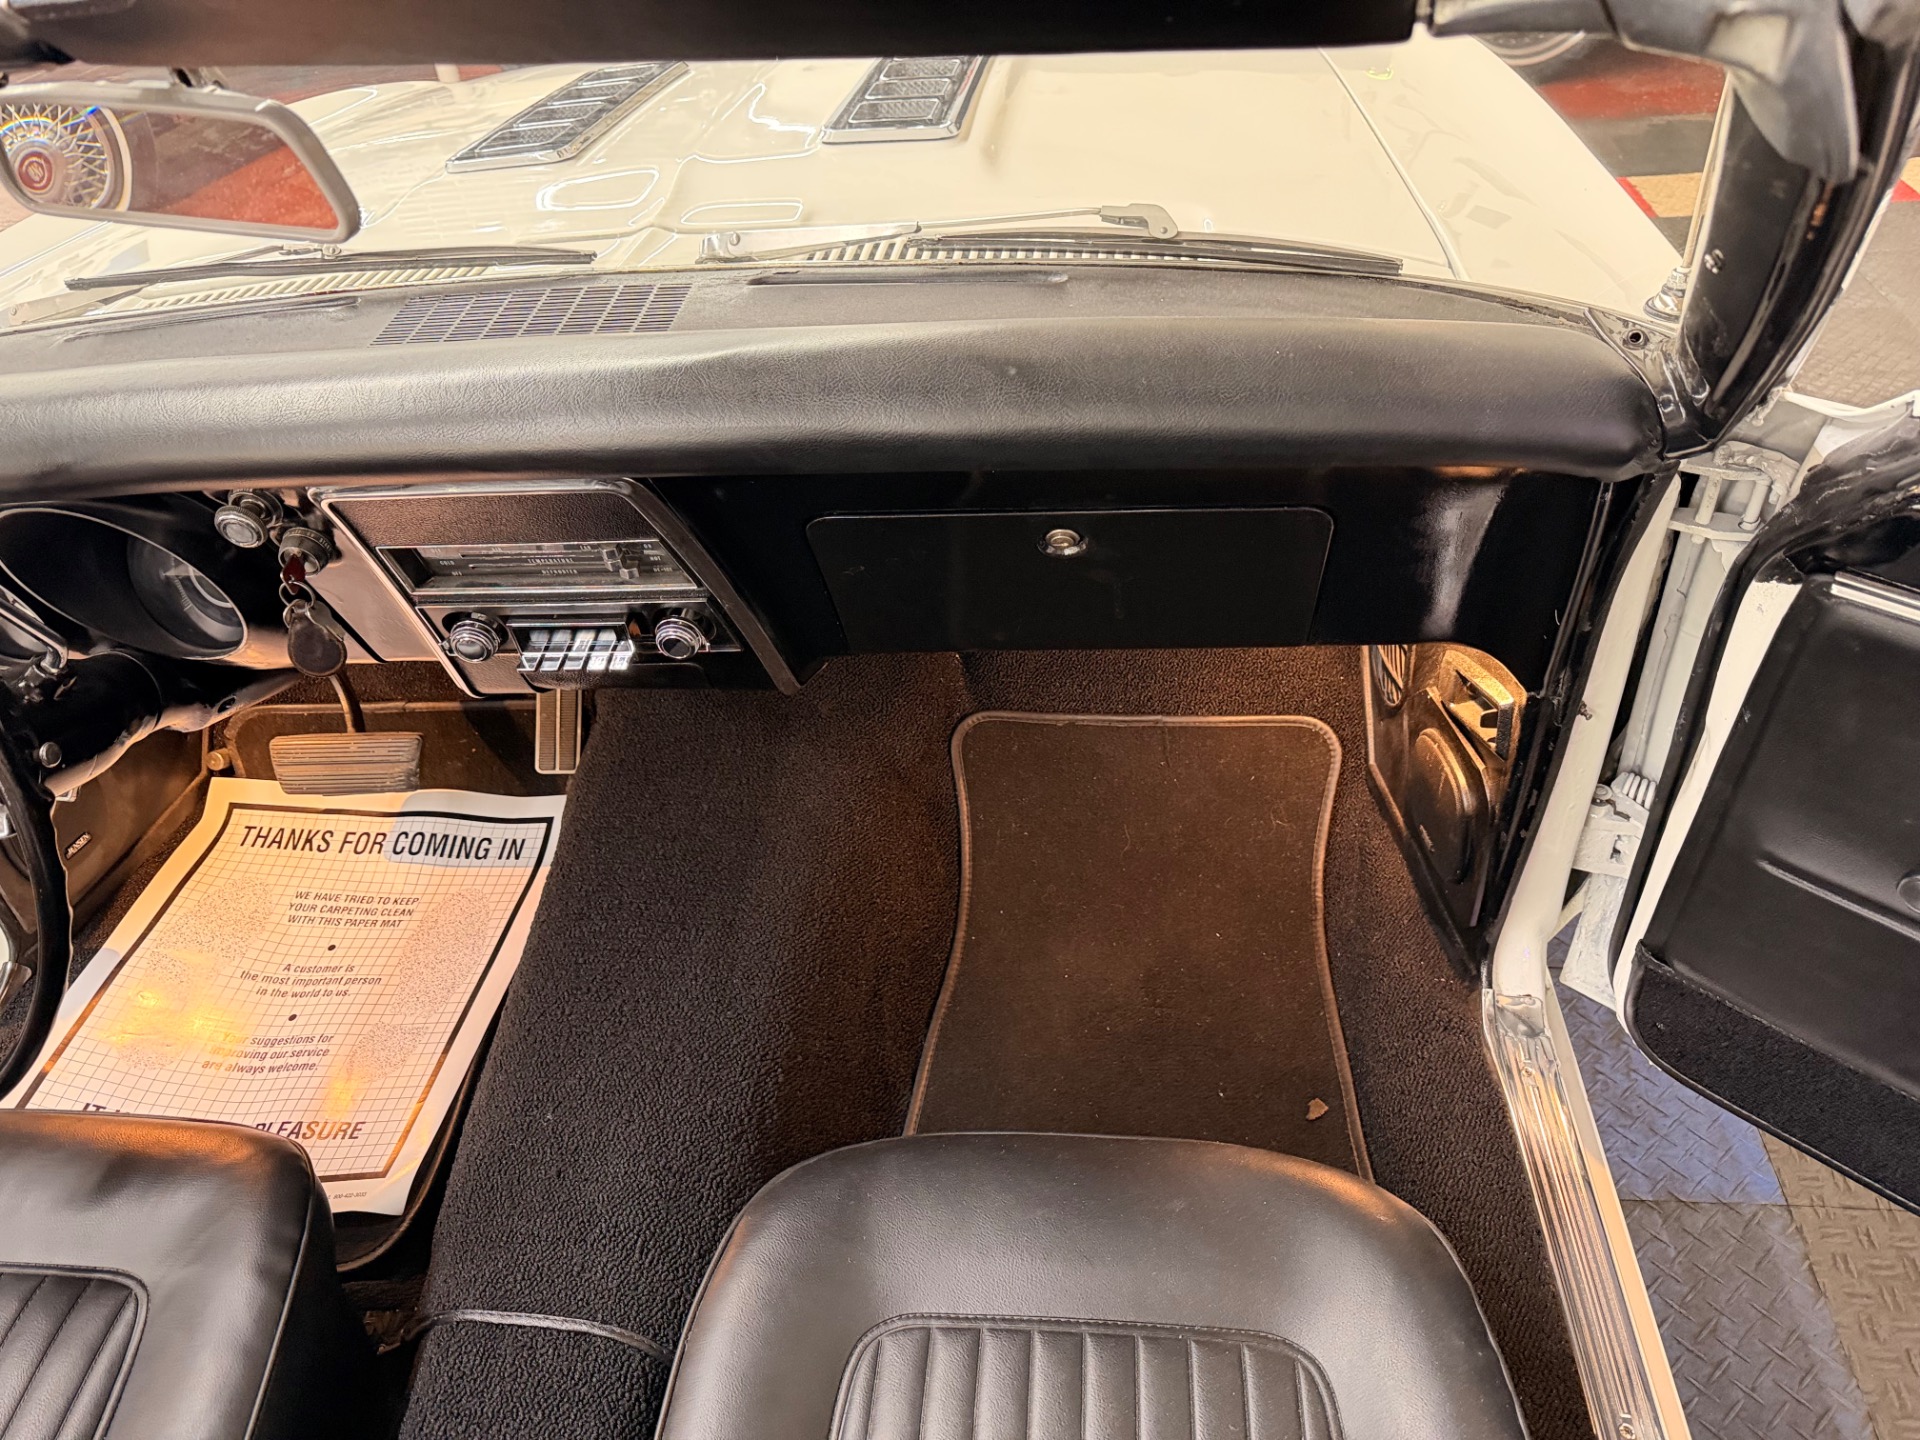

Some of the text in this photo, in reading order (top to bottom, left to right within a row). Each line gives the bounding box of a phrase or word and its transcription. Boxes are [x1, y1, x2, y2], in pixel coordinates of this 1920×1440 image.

[240, 826, 526, 860] THANKS FOR COMING IN
[295, 891, 419, 906] WE HAVE TRIED TO KEEP
[289, 902, 414, 917] YOUR CARPETING CLEAN
[287, 915, 404, 928] WITH THIS PAPER MAT
[282, 963, 355, 973] A customer is
[240, 970, 382, 988] the most important person
[255, 986, 351, 998] in the world to us.
[222, 1032, 334, 1048] Your suggestions for
[208, 1046, 330, 1061] improving our service
[201, 1060, 318, 1076] are always welcome.
